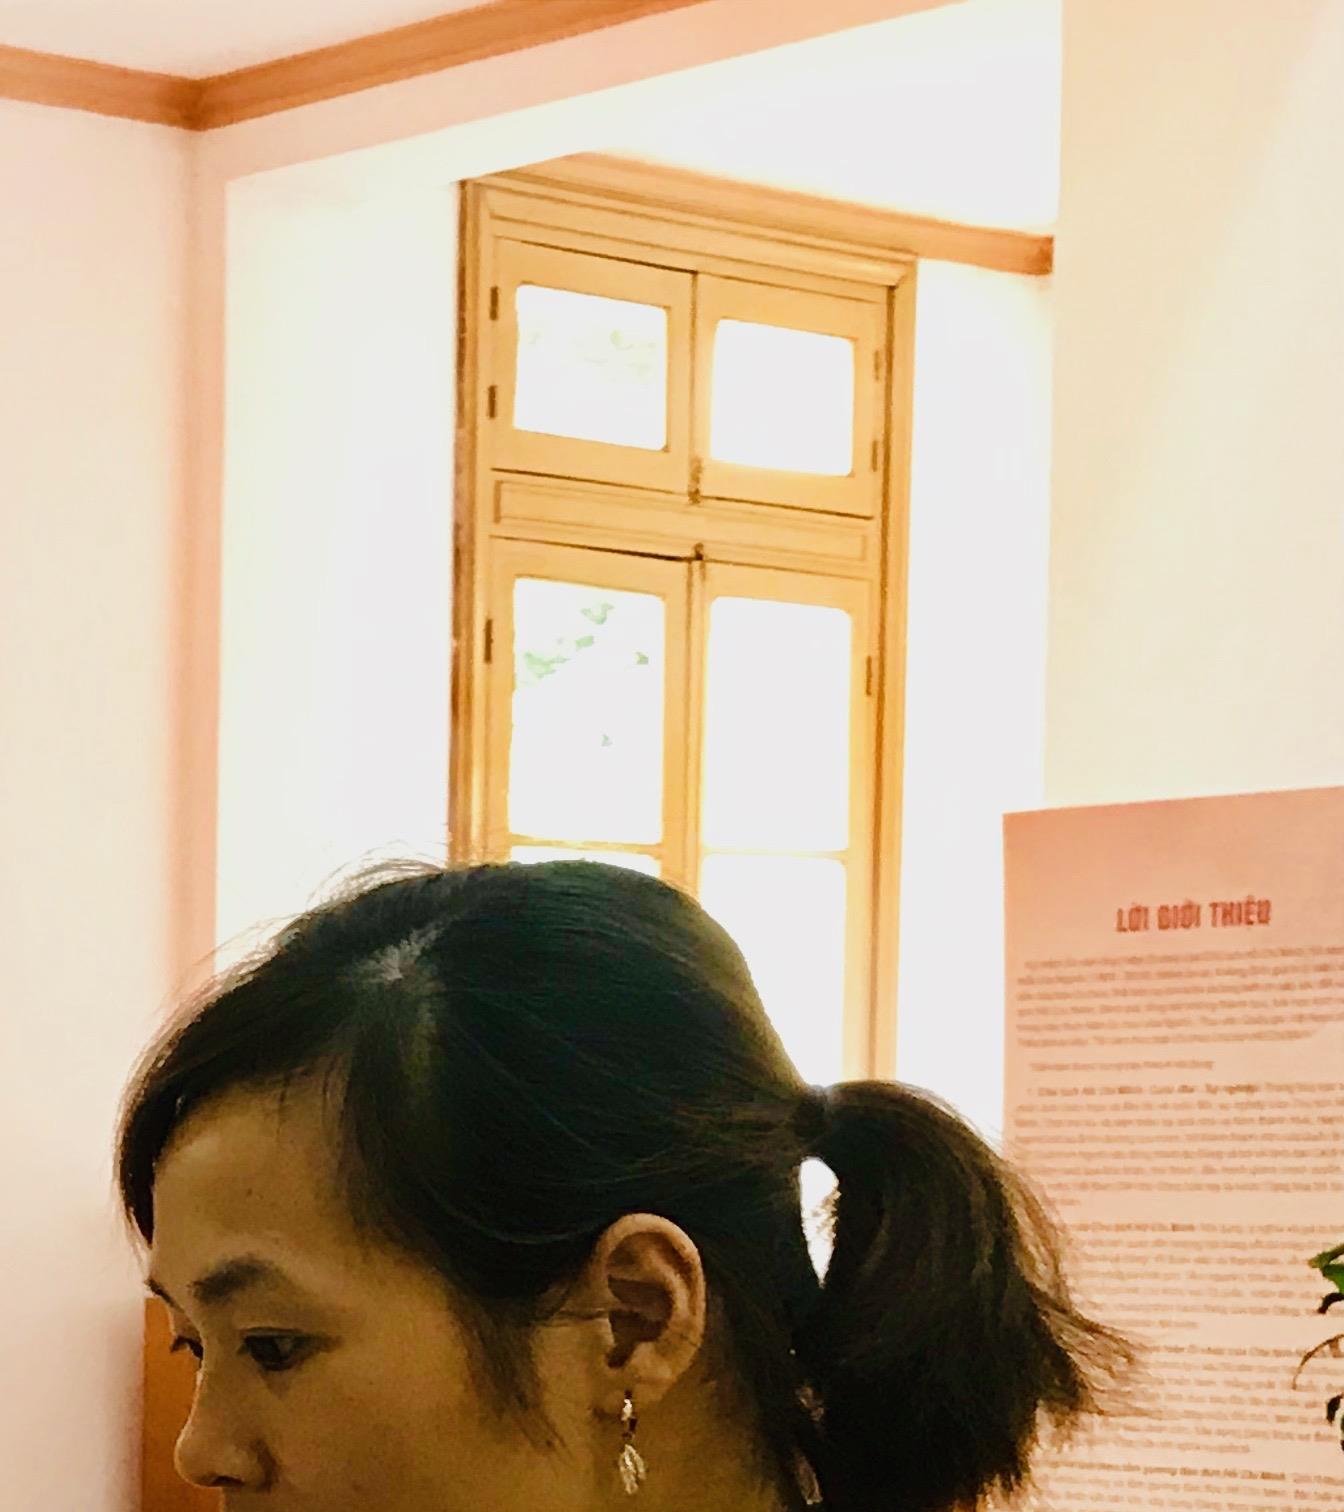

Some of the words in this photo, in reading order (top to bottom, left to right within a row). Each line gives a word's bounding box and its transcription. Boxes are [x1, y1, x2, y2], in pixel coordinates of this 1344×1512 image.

[1117, 902, 1149, 932] LỜI
[1157, 897, 1201, 930] GIỚI
[1209, 895, 1271, 930] THIỆU
